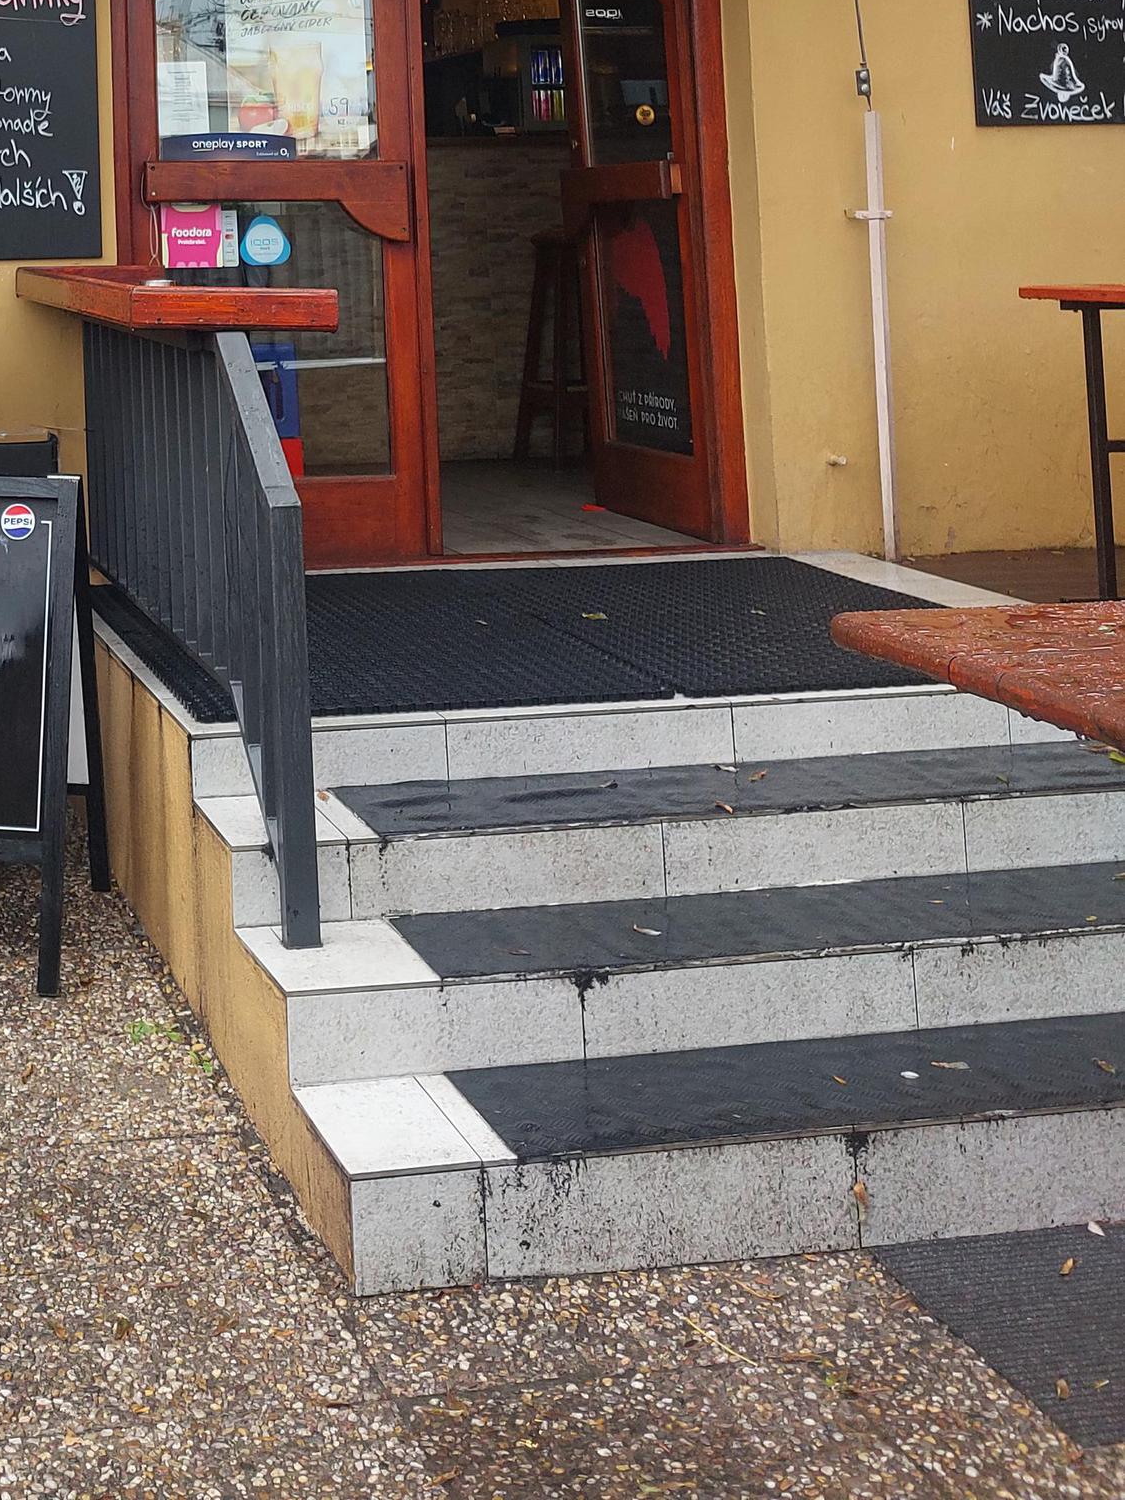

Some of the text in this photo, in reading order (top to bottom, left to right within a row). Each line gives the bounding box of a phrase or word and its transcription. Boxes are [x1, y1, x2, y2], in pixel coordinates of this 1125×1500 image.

[982, 88, 1013, 118] Váš
[192, 137, 269, 152] oneplay SPORT
[171, 227, 212, 238] foodora
[3, 516, 33, 526] PEPSI
